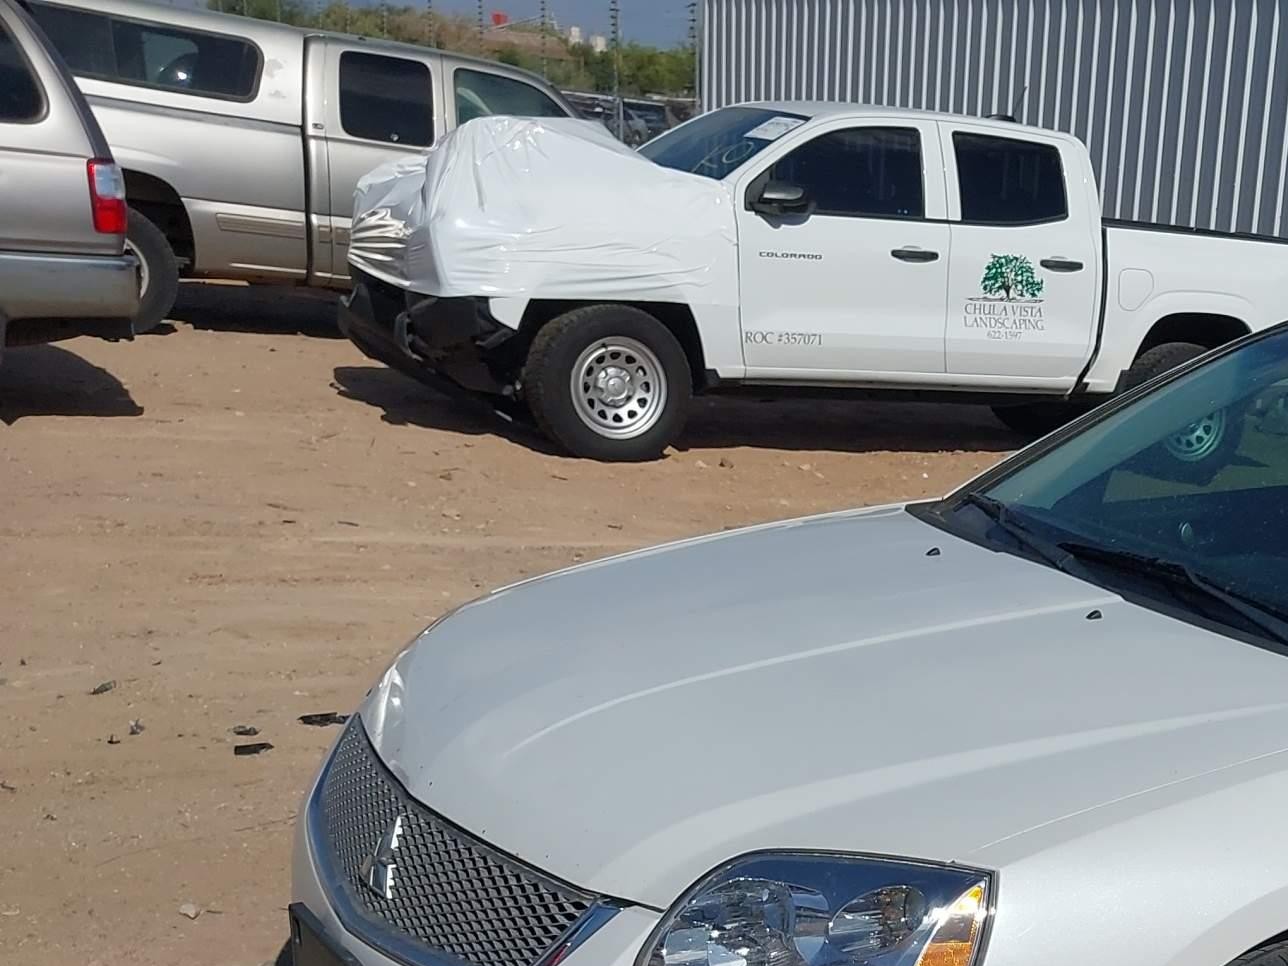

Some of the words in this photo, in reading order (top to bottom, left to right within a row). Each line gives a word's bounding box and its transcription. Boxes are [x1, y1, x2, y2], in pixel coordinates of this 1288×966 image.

[759, 251, 823, 260] COLORADO
[964, 303, 1008, 316] CHULA
[1011, 305, 1043, 318] VISTA
[963, 316, 1045, 331] LANDSCAPING
[745, 331, 775, 344] ROC
[777, 332, 822, 345] #357071
